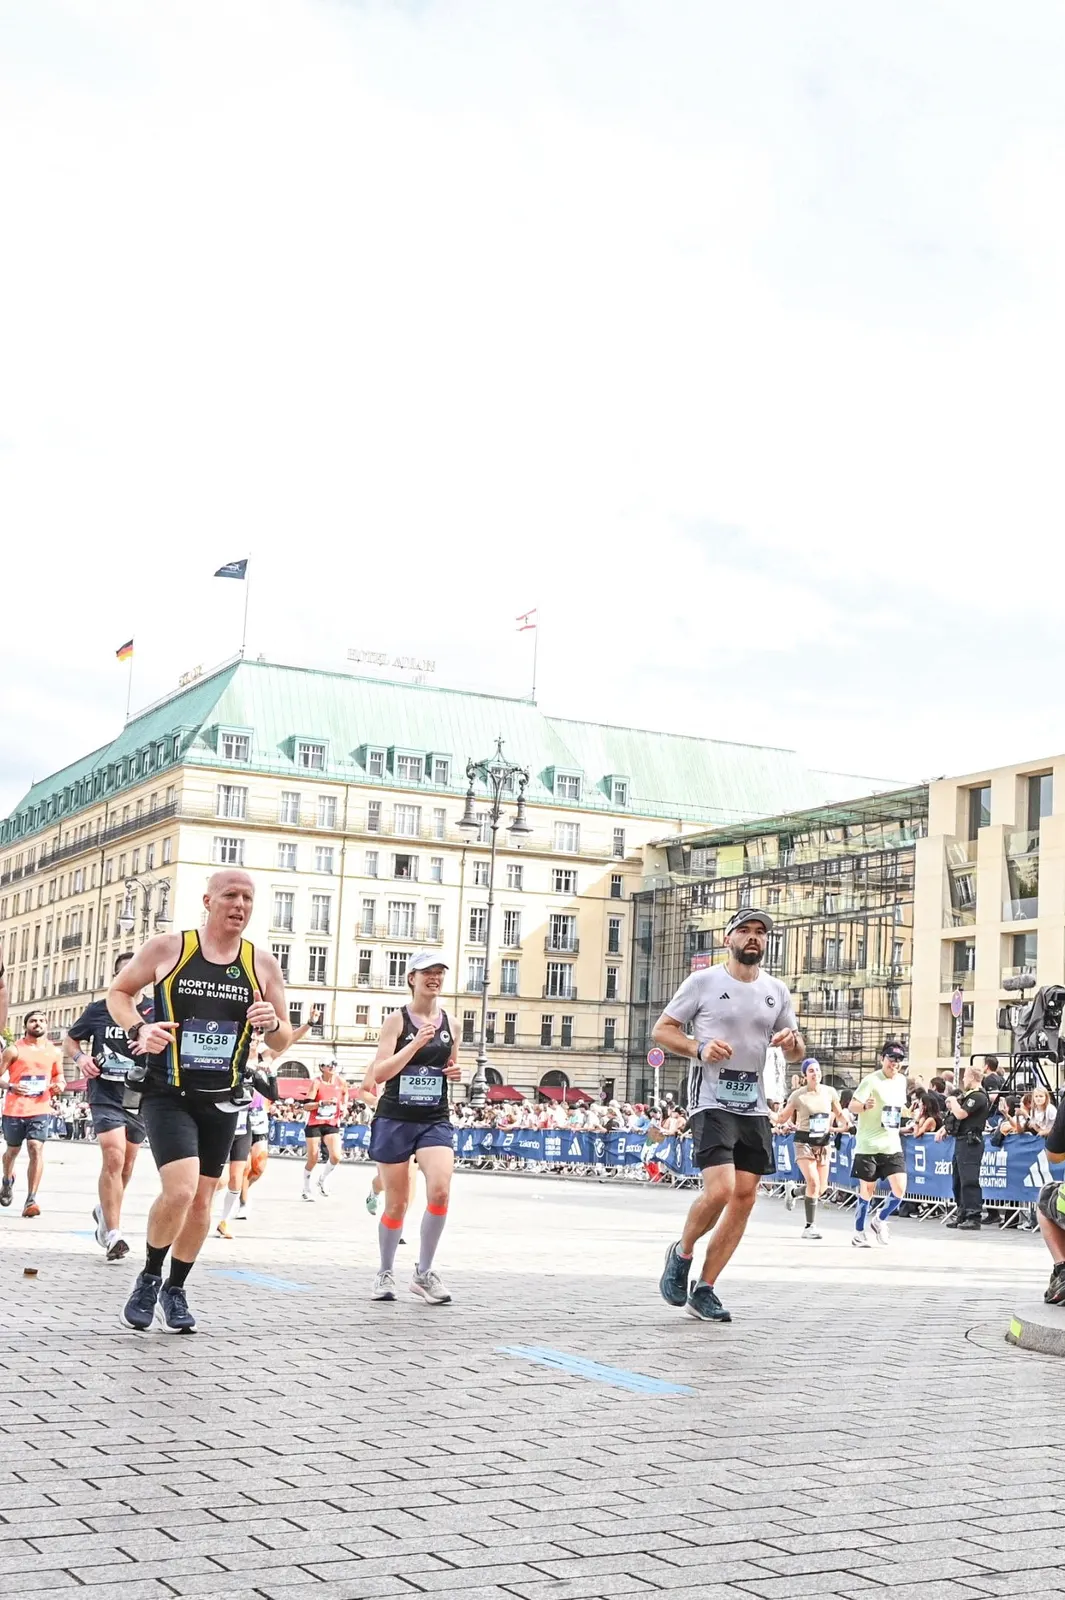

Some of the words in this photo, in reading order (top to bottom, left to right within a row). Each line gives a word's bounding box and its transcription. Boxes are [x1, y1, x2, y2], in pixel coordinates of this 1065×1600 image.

[179, 979, 215, 990] NORTH
[218, 983, 249, 996] HERTS
[178, 987, 204, 996] ROAD
[206, 990, 249, 1003] RUNNERS
[192, 1033, 228, 1045] 15638
[409, 1077, 437, 1086] 28573
[981, 1151, 996, 1166] MW
[980, 1166, 996, 1176] ERLIN
